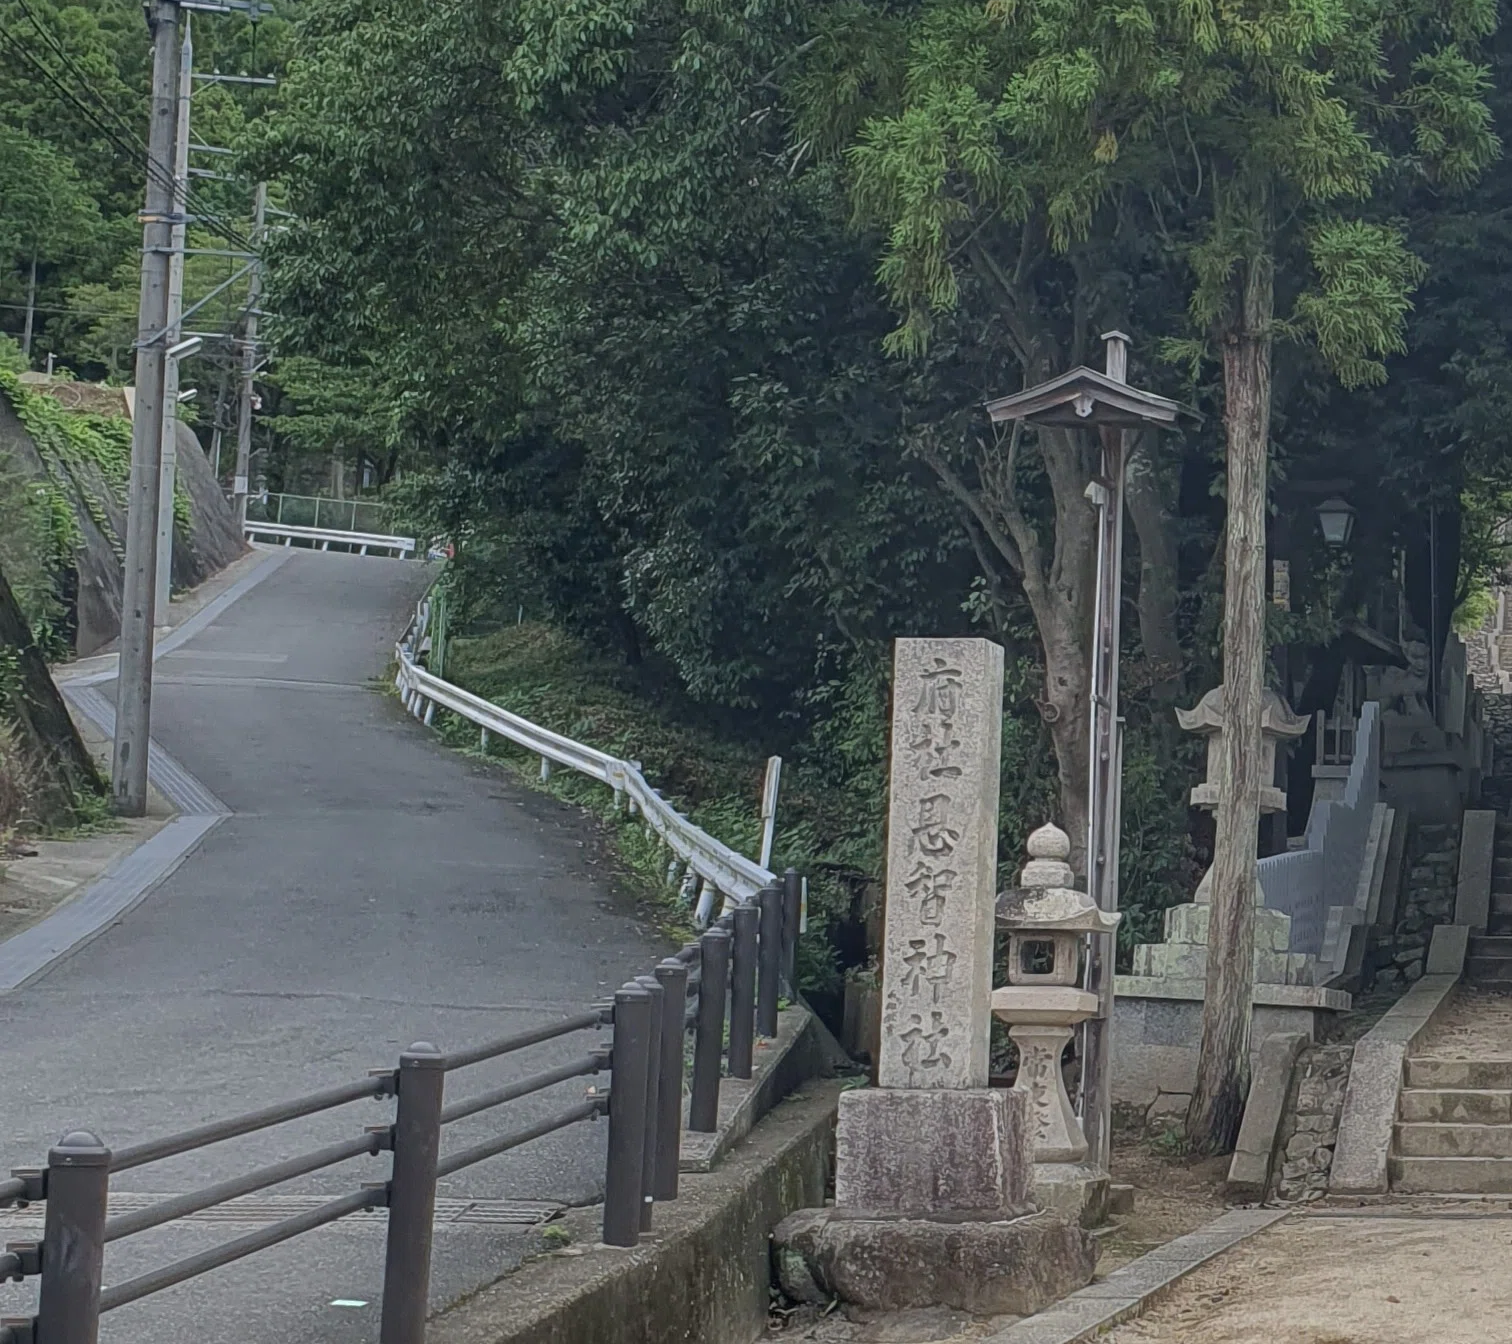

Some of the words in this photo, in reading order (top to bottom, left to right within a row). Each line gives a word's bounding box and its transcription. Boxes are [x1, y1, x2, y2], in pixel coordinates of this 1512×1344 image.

[900, 657, 963, 1076] 府社恩智神社
